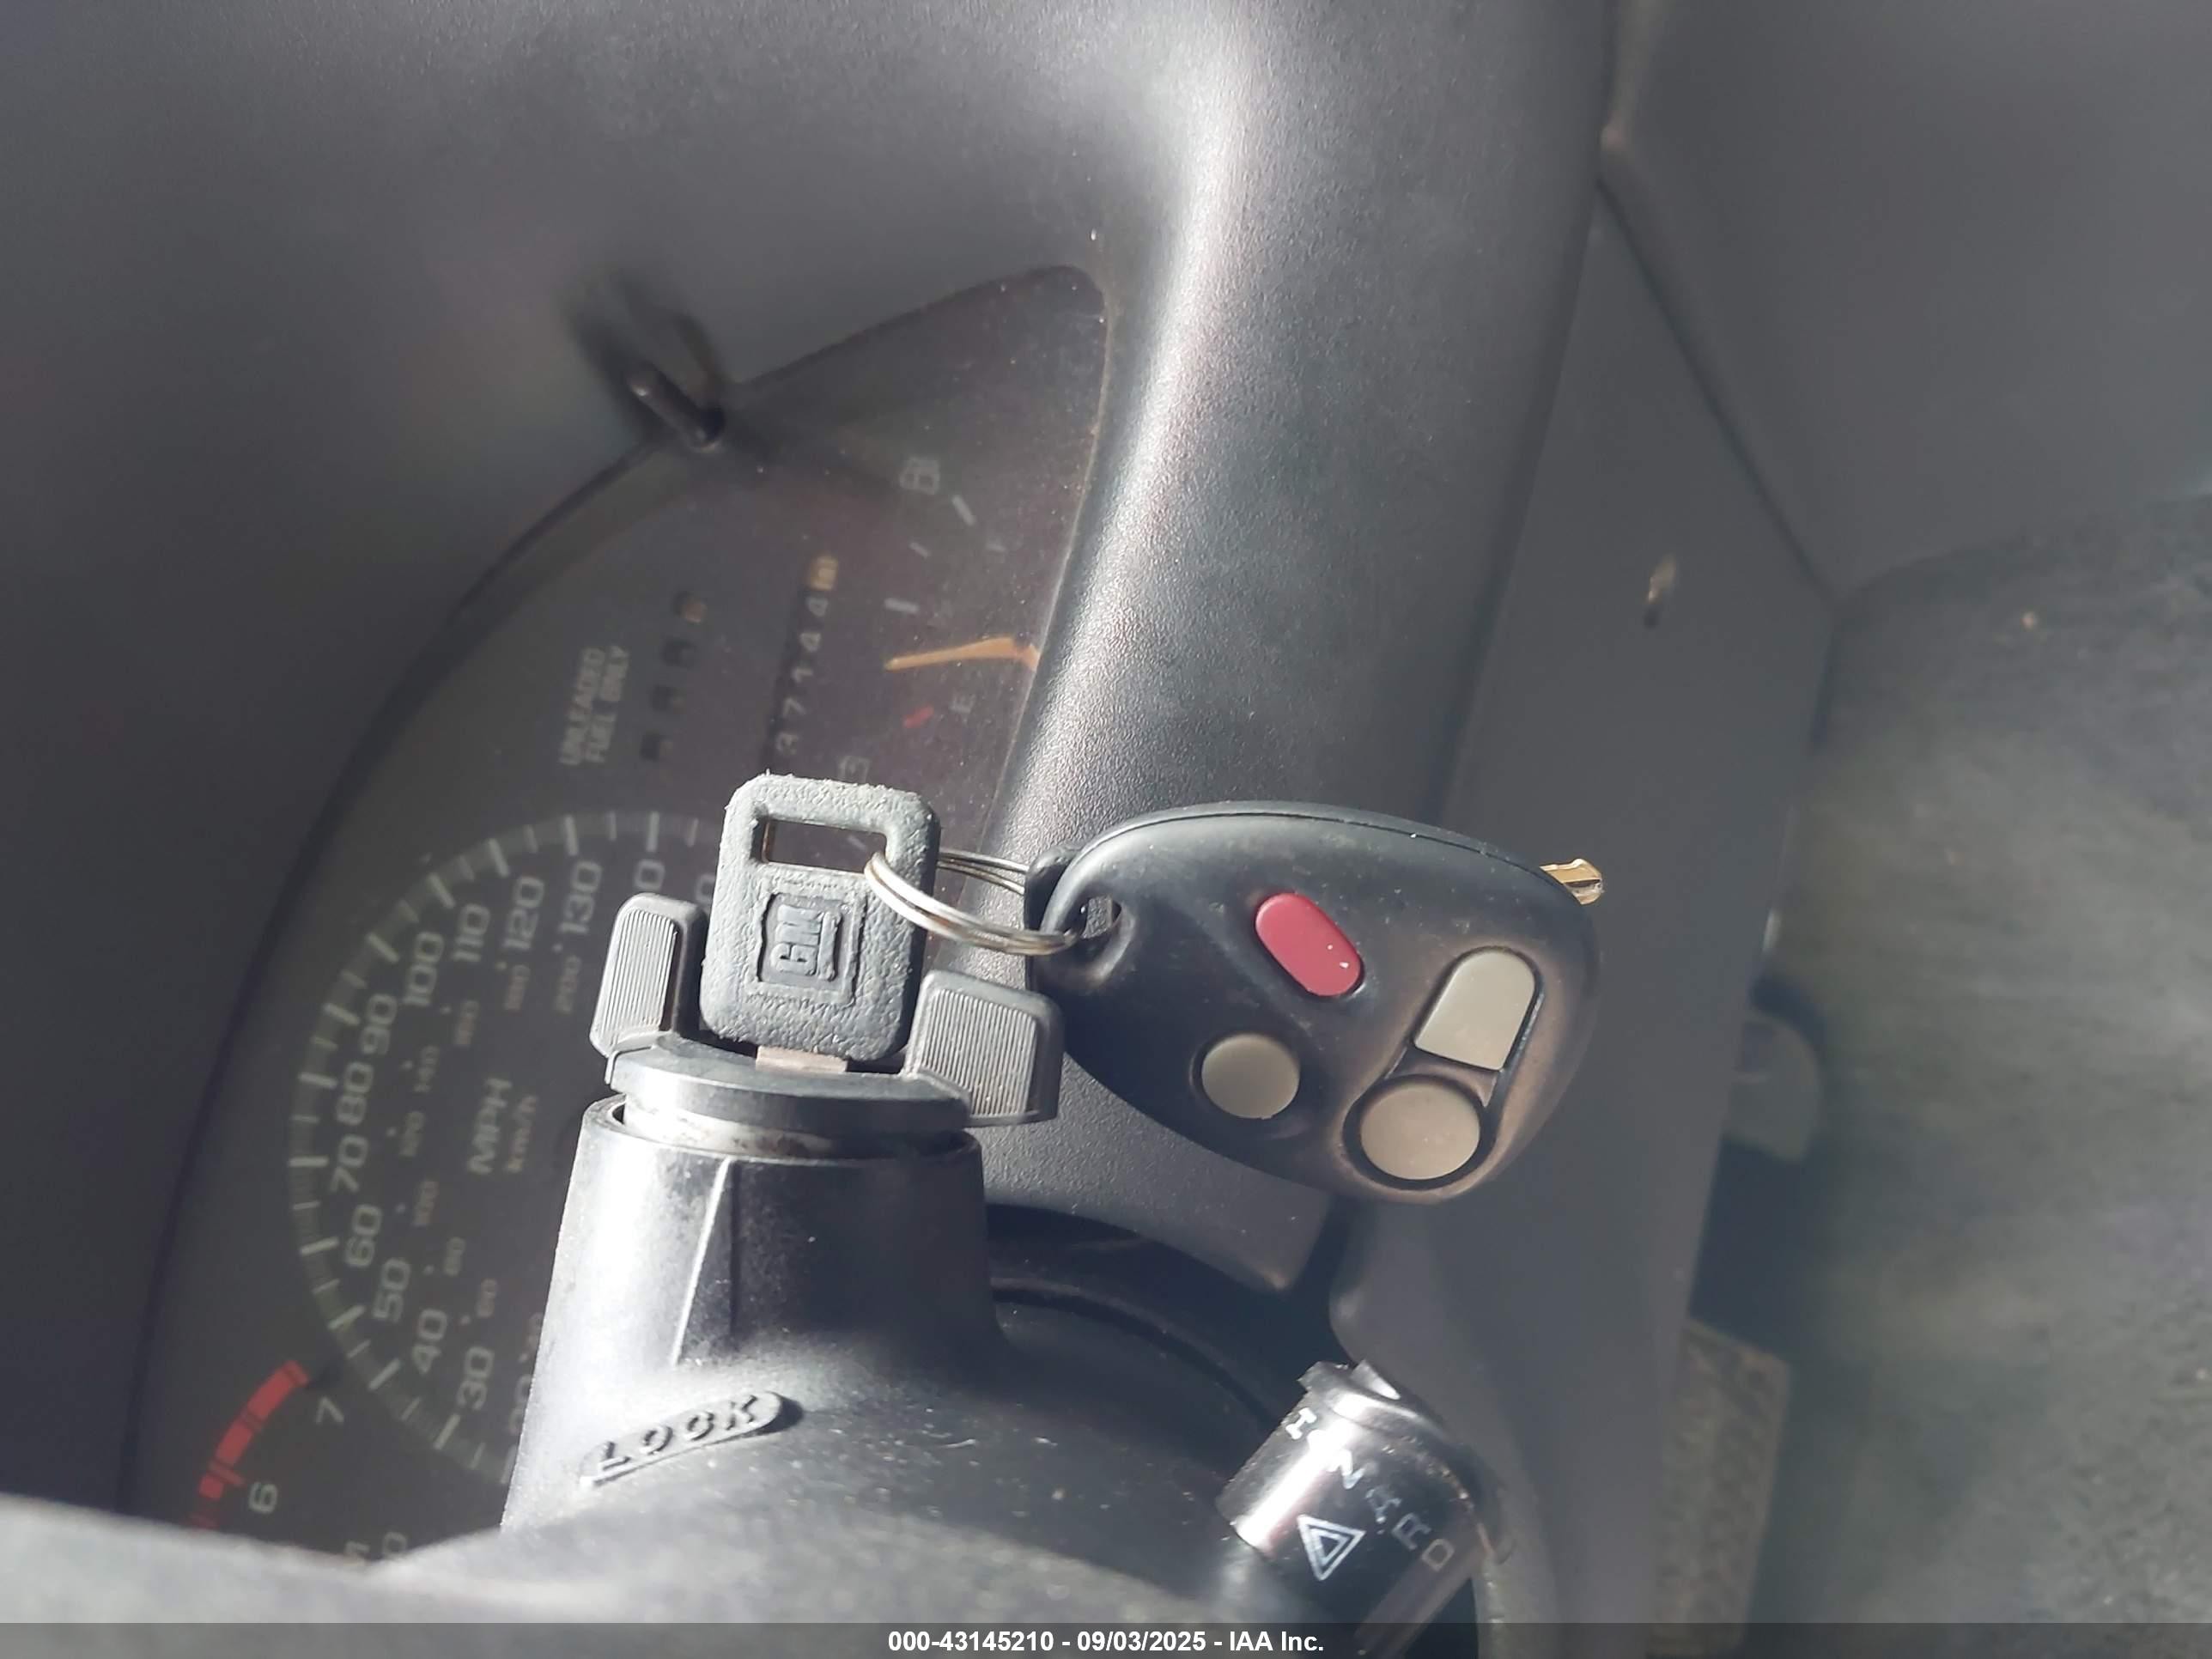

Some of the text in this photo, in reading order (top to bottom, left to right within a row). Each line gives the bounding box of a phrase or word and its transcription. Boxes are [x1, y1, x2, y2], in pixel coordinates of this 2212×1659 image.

[504, 877, 545, 950] 120
[558, 861, 601, 933] 130
[453, 903, 490, 961] 110
[771, 905, 824, 976] GM
[404, 932, 444, 1005] 100
[360, 994, 397, 1054] 90
[336, 1062, 374, 1125] 80
[466, 1079, 512, 1174] MPH
[330, 1134, 369, 1193] 70
[345, 1204, 382, 1267] 60
[373, 1258, 411, 1322] 50
[411, 1309, 447, 1373] 40
[457, 1346, 494, 1409] 30
[315, 1397, 344, 1424] 7
[599, 1395, 757, 1470] LOCK
[248, 1481, 278, 1514] 6
